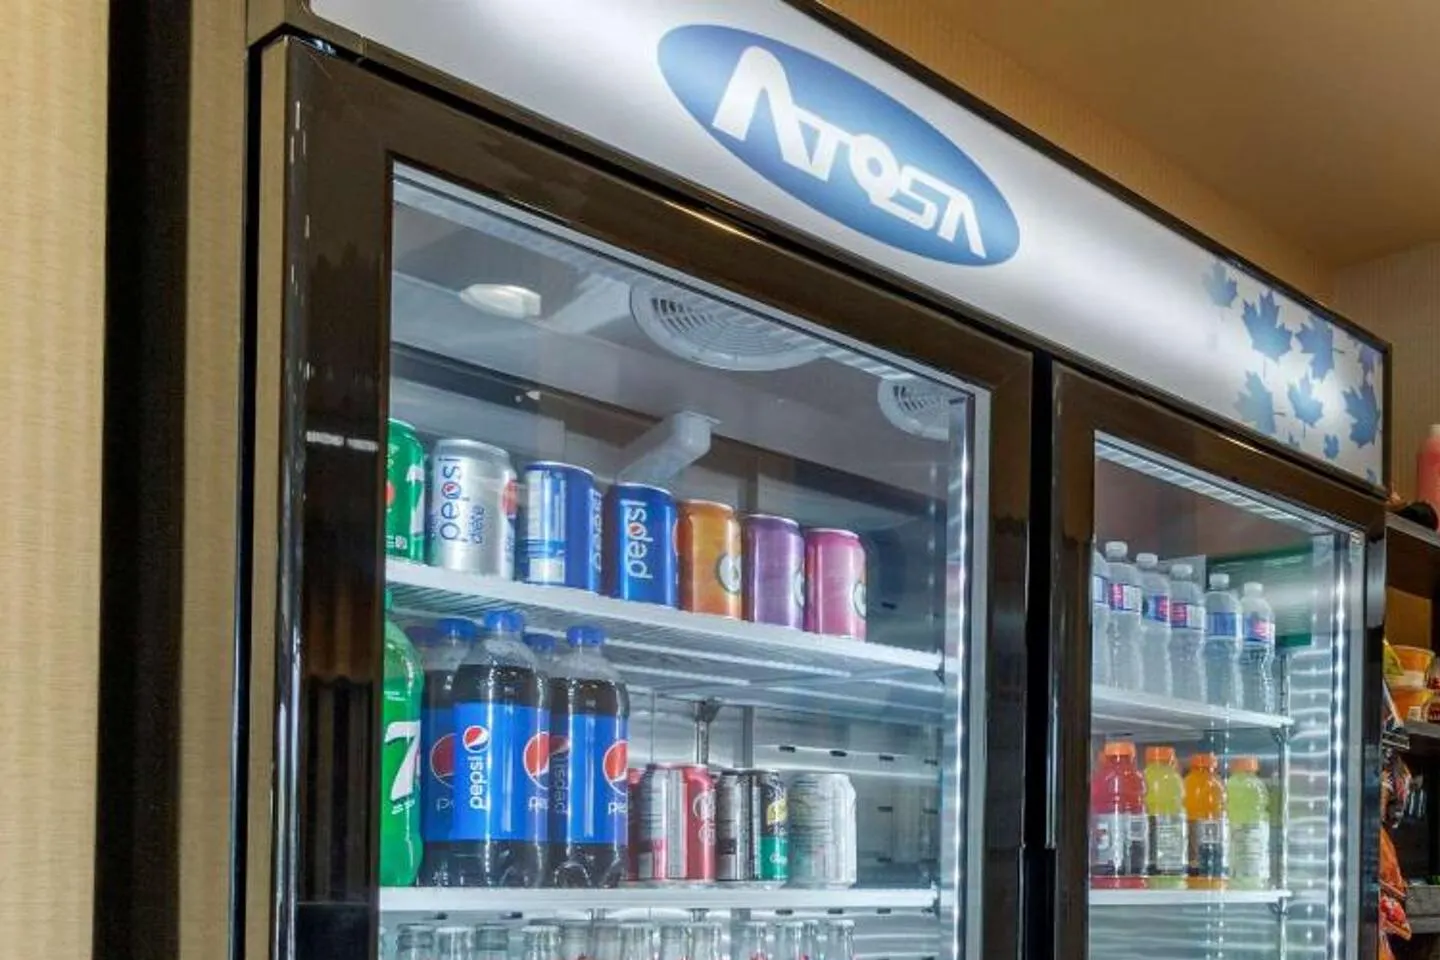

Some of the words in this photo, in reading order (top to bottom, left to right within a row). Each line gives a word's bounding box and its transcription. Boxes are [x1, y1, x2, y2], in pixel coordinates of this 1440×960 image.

[711, 44, 987, 259] ATOSA
[438, 457, 470, 543] pepsi
[623, 499, 654, 579] pepsi
[467, 755, 488, 811] pepsi
